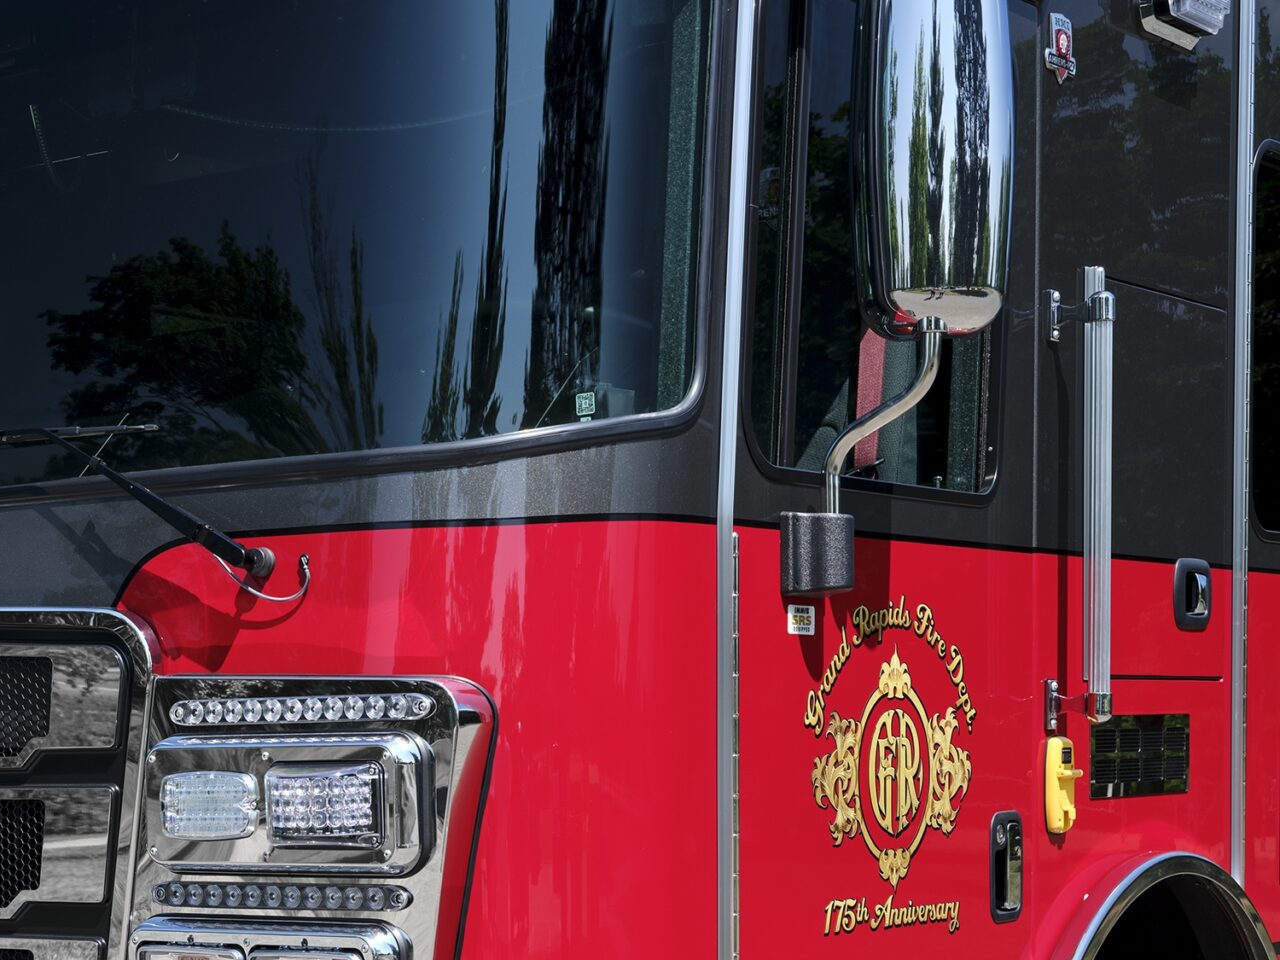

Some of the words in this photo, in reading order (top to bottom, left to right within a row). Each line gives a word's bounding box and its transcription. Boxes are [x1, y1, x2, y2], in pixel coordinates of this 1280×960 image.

[792, 614, 812, 626] SRS
[804, 626, 851, 735] Grand
[852, 595, 912, 645] Rapids
[913, 603, 947, 657] Fire
[945, 645, 977, 733] Dept.
[823, 896, 869, 935] 175th
[869, 894, 960, 933] Anniversary
